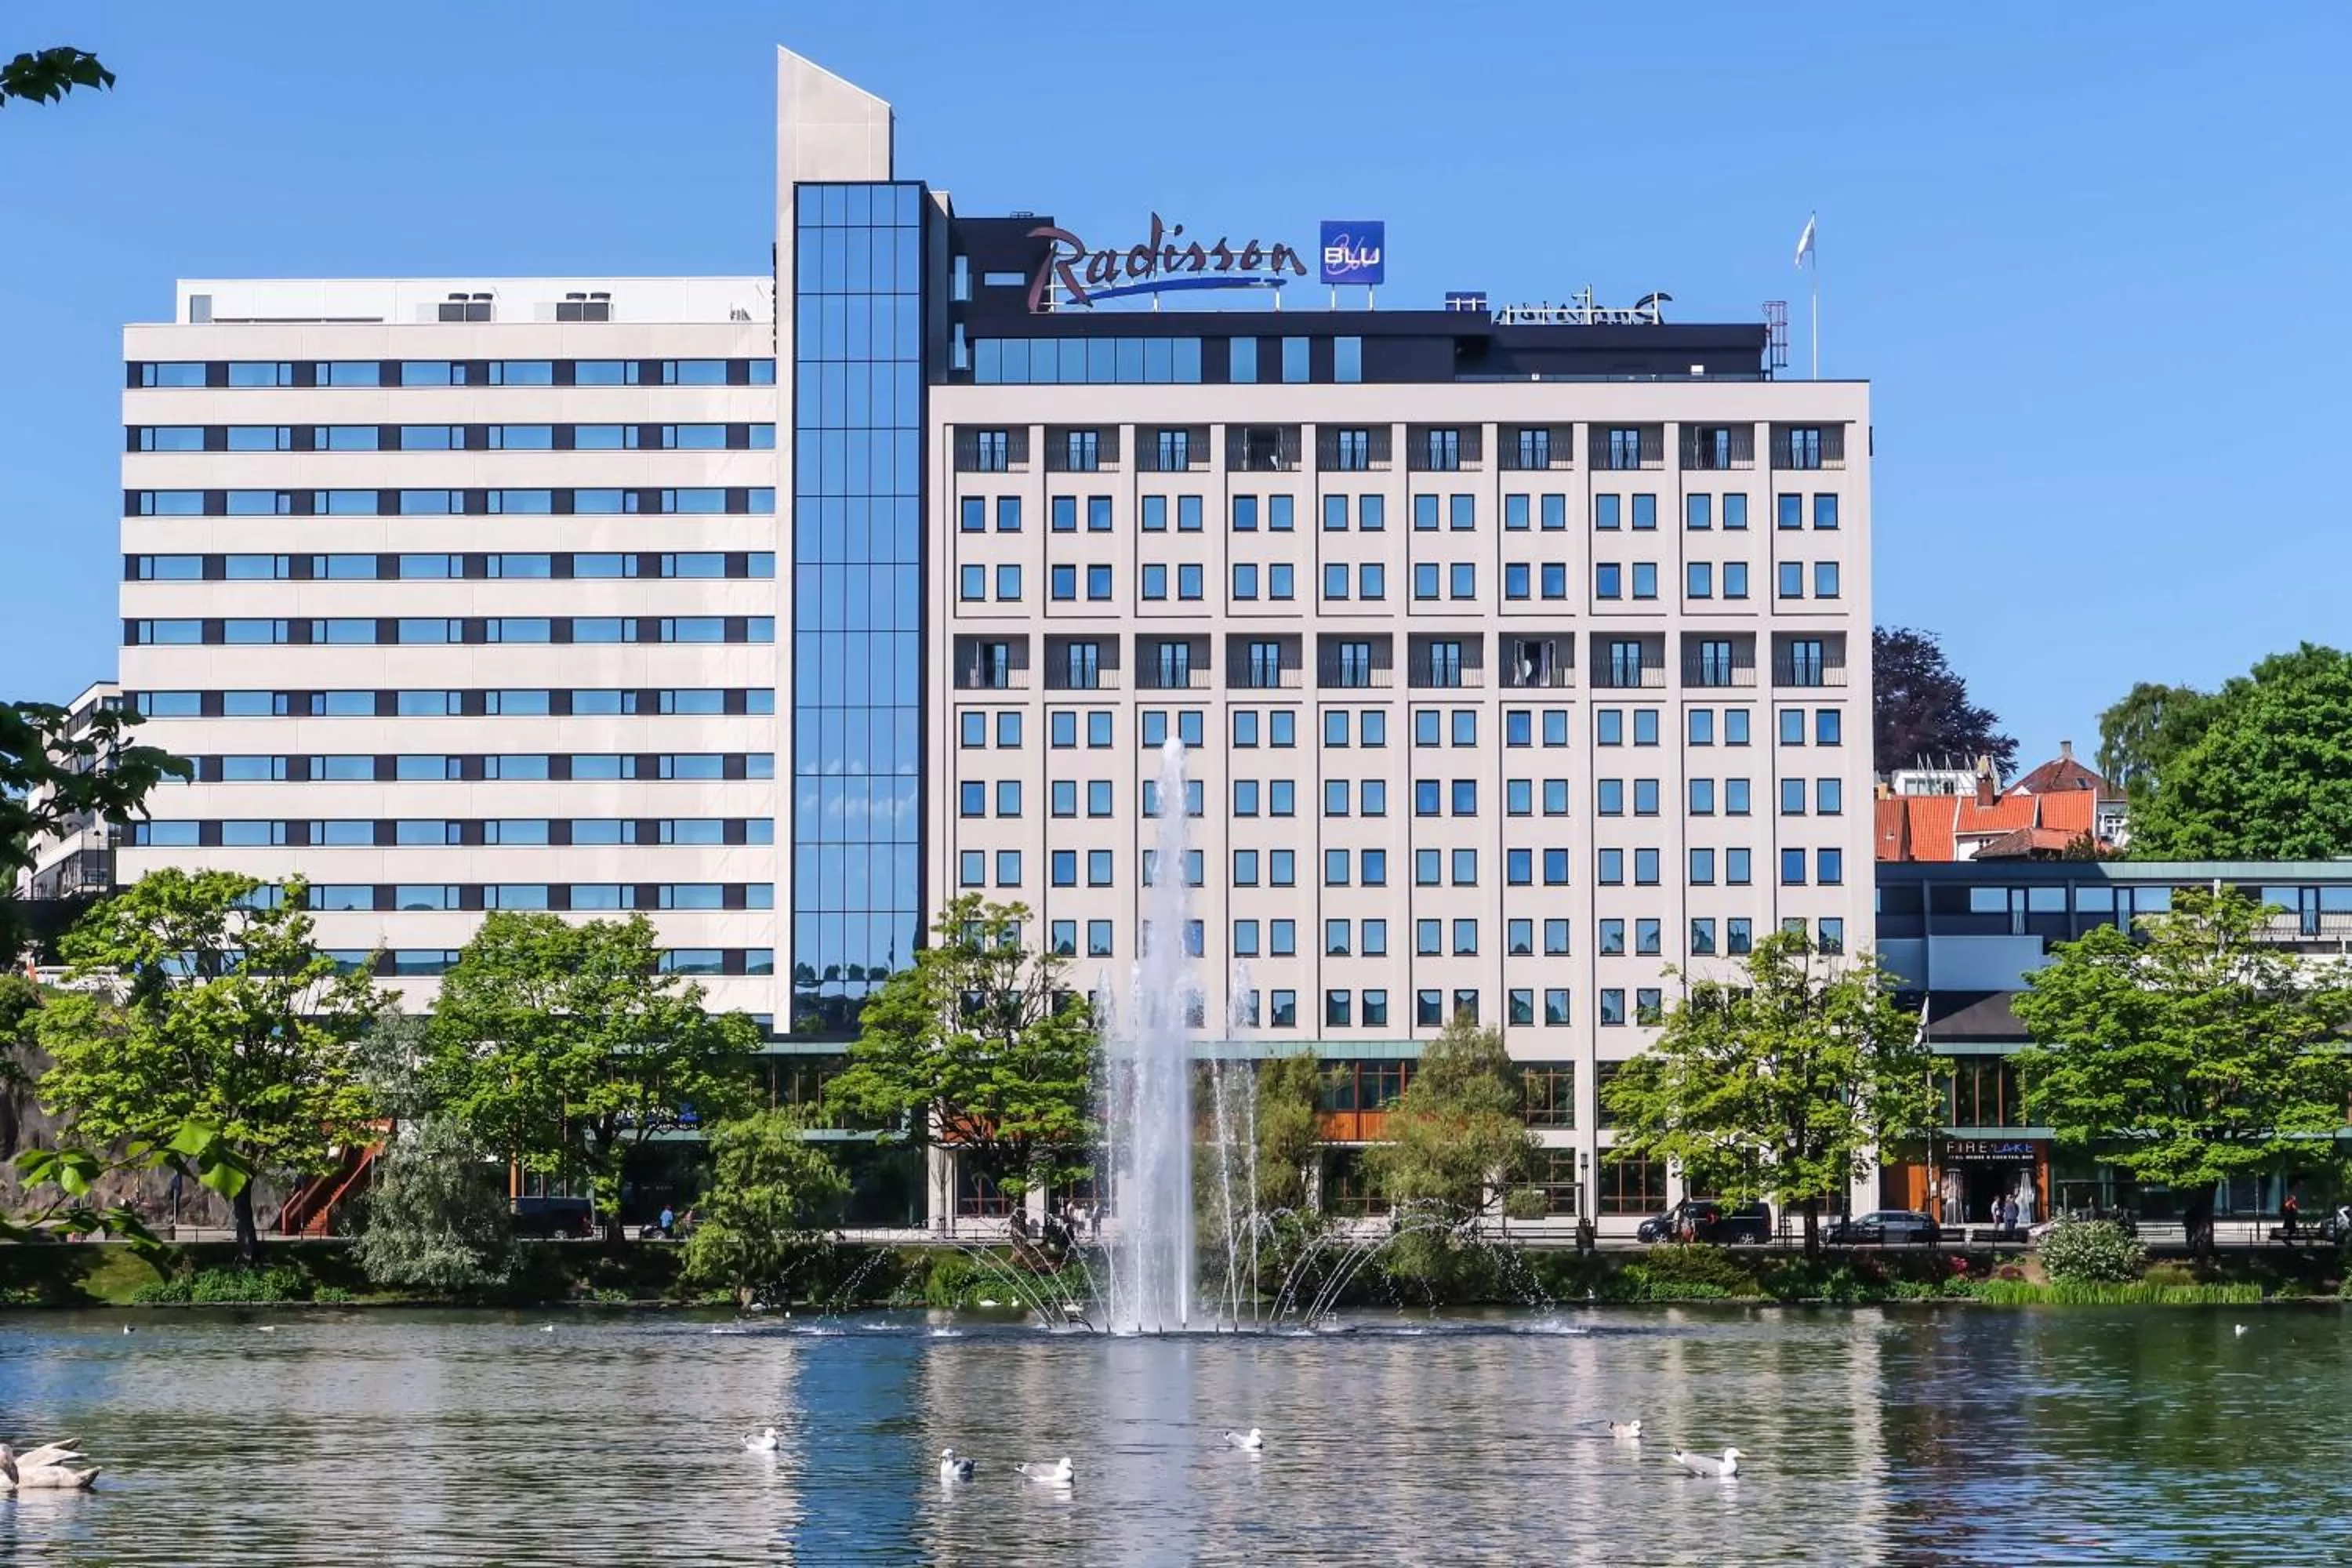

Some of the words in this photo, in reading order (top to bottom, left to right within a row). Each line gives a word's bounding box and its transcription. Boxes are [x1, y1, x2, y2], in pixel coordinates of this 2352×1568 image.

[1028, 212, 1307, 313] Radisson
[1947, 1142, 1987, 1153] FIRE
[1994, 1142, 2033, 1153] LAKE
